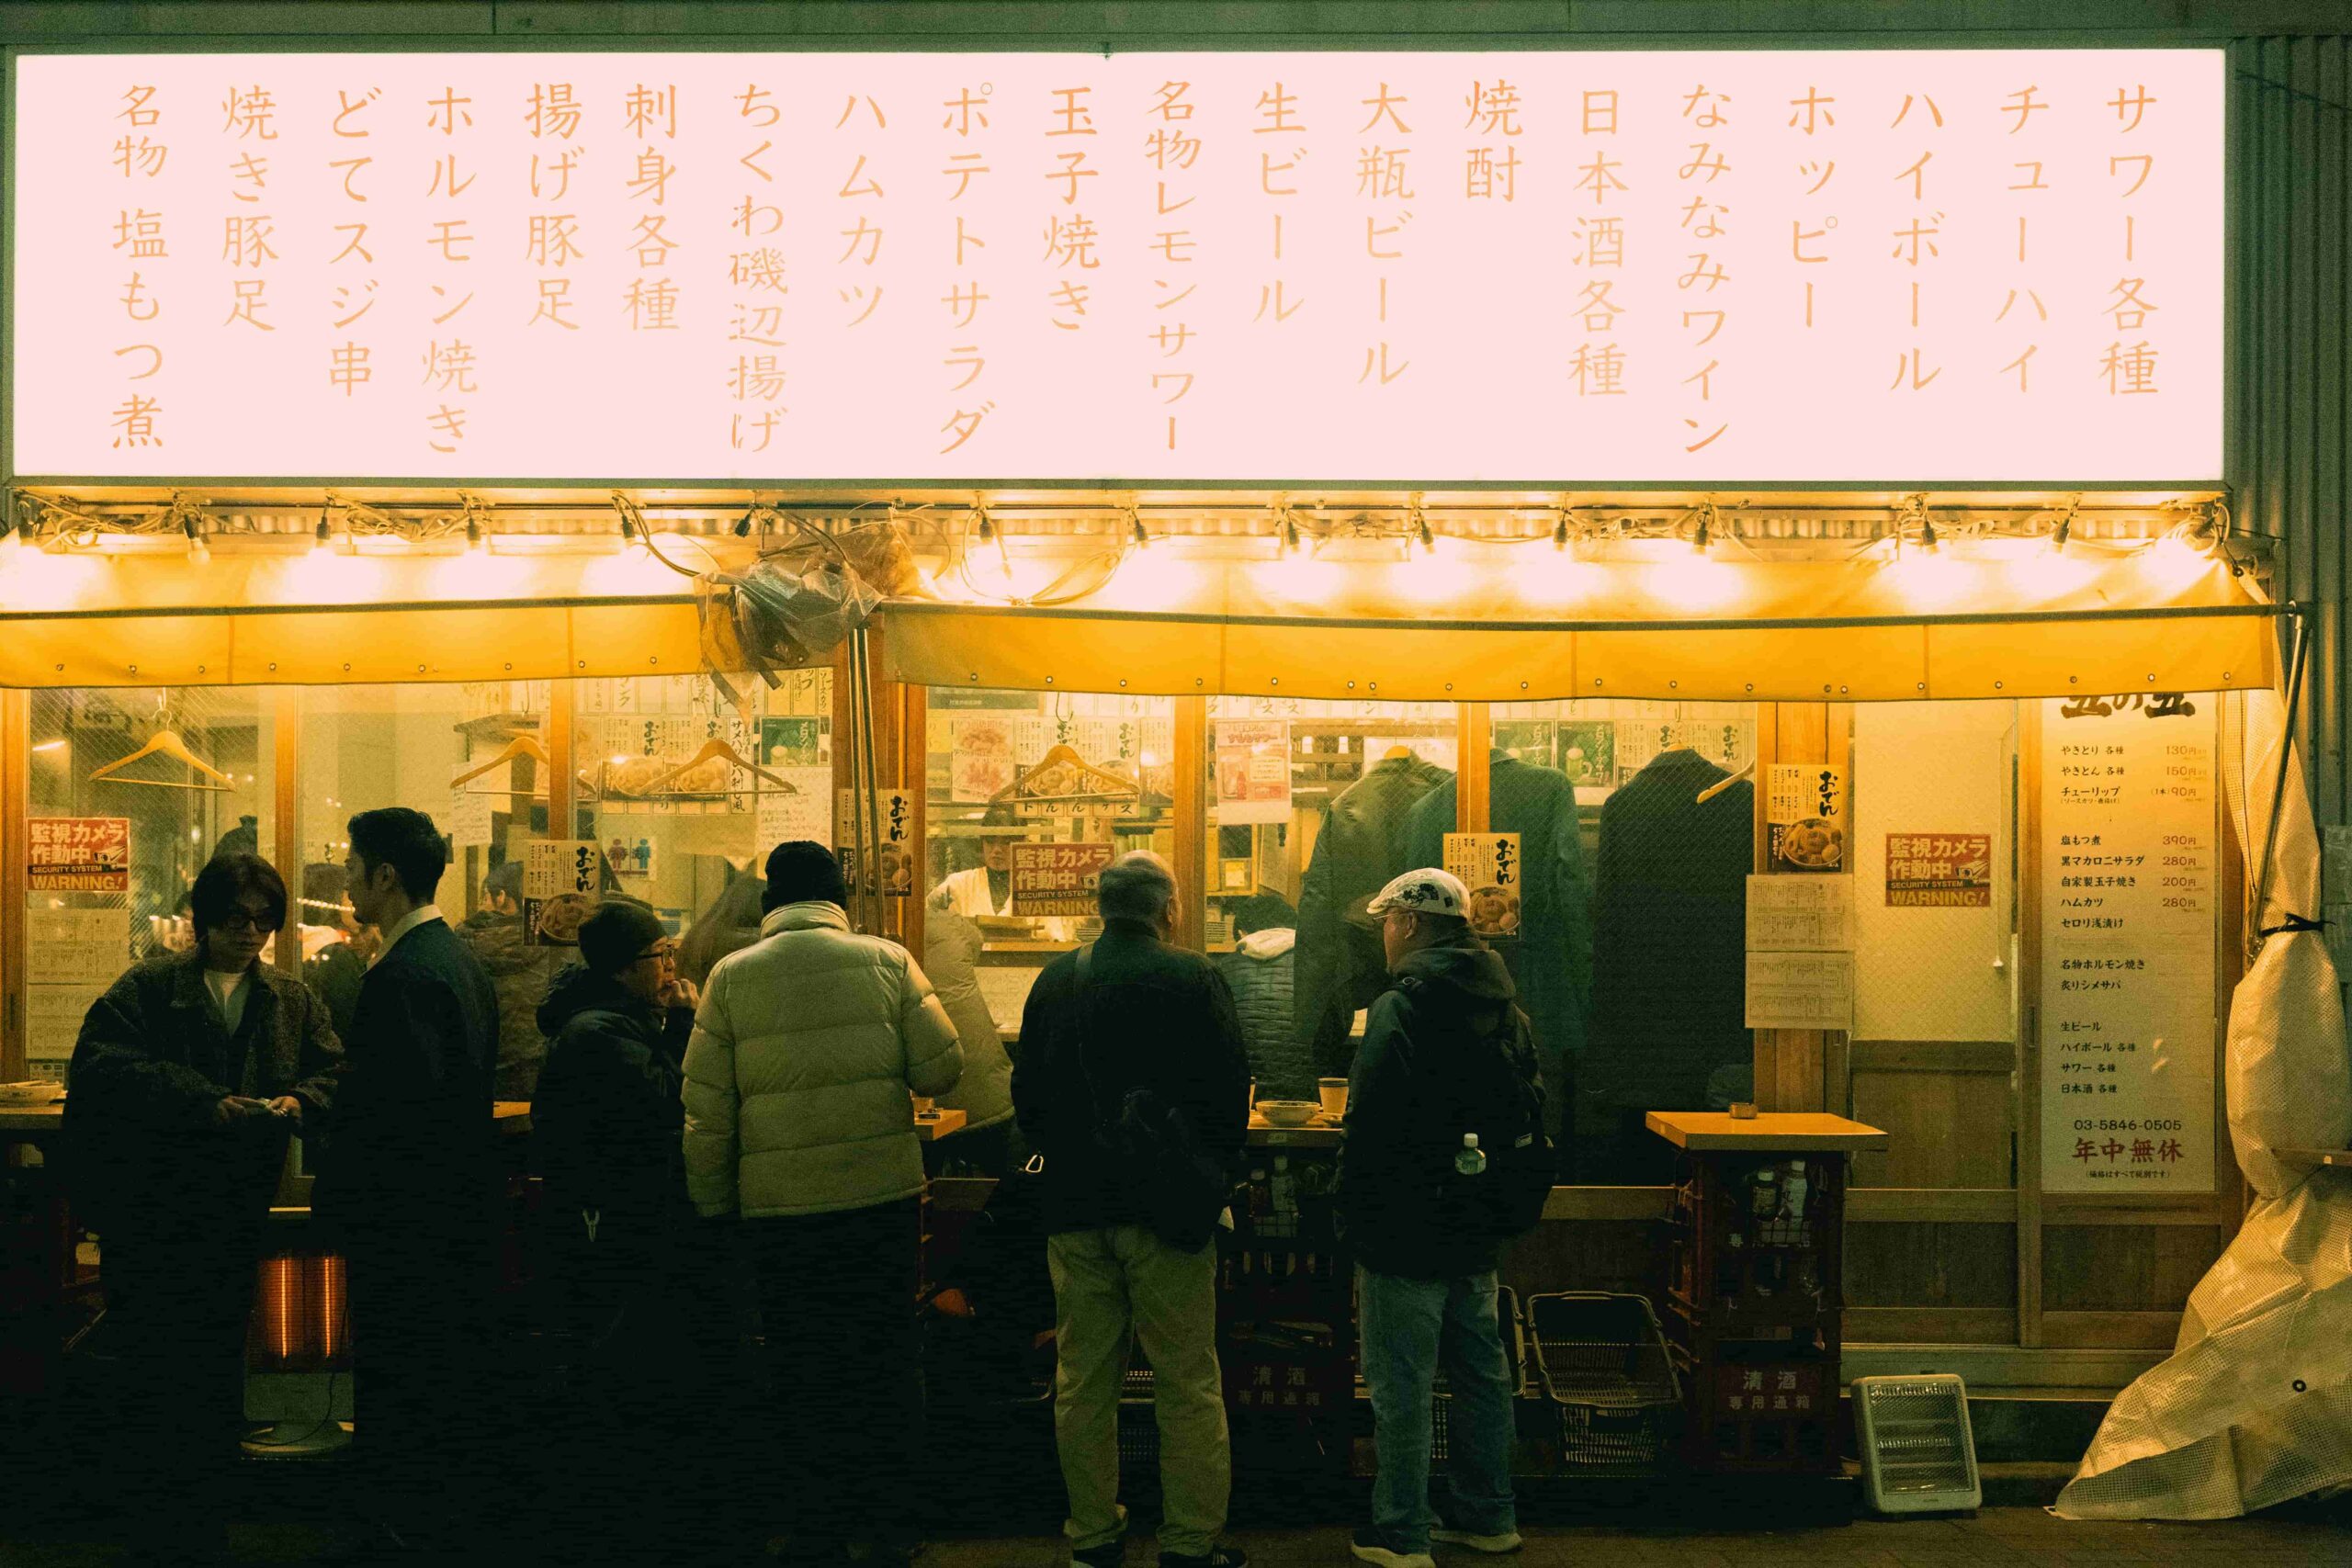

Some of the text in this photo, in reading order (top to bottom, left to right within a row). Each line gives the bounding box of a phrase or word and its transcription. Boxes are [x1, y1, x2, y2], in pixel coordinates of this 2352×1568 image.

[1464, 79, 1523, 202] 焼酎
[221, 85, 279, 332] 焼き豚足
[524, 83, 585, 331] 揚げ豚足
[623, 83, 680, 331] 刺身各種
[836, 95, 887, 326] ハムカツ
[1044, 86, 1101, 331] 玉子焼き
[1252, 82, 1307, 321] 生ビール
[1789, 85, 1838, 328] ホッピー
[329, 86, 382, 397] どてスジ串
[1356, 82, 1415, 385] 大瓶ビール
[1568, 90, 1629, 397] 日本酒各種
[1891, 85, 1945, 390] ハイボール
[1996, 85, 2050, 392] チューハイ
[2099, 84, 2159, 396] サワー各種
[423, 86, 478, 453] ホルモン焼き
[940, 82, 996, 455] ポテトサラダ
[1145, 81, 1202, 450] 名物レモンサワー
[1678, 84, 1731, 453] なみなみワイン
[643, 720, 661, 757] おでん
[1119, 722, 1136, 759] おでん
[1722, 725, 1739, 761] おでん
[2061, 746, 2098, 755] やきとり
[2106, 746, 2124, 755] 各種
[2061, 766, 2100, 776] やきとん
[2107, 766, 2124, 775] 各種
[1818, 771, 1838, 817] おでん
[2061, 786, 2120, 796] チューリップ
[30, 823, 125, 843] 監視カメラ
[889, 795, 910, 841] おでん
[30, 844, 91, 864] 作動中
[1890, 837, 1986, 858] 監視カメラ
[2061, 835, 2196, 846] 塩もつ煮 390円
[575, 846, 595, 892] おでん
[1015, 848, 1111, 869] 監視カメラ
[1496, 839, 1517, 886] おでん
[1889, 859, 1951, 880] 作動中
[2061, 855, 2196, 866] 黒マカロニサラダ 280円
[32, 875, 123, 890] WARNING!
[1015, 869, 1077, 890] 作動中
[1017, 889, 1089, 899] SECURITY SYSTEM
[1891, 880, 1963, 889] SECURITY SYSTEM
[2061, 876, 2196, 887] 自家製玉子焼き 200円
[2061, 897, 2196, 908] ハムカツ 280円
[2061, 918, 2123, 929] セロリ浅漬け
[2061, 959, 2145, 970] 名物ホルモン焼き
[2061, 1021, 2101, 1032] 生ビール
[2061, 1043, 2136, 1053] ハイボール 各種
[2061, 1063, 2116, 1073] サワー 各種
[2061, 1084, 2117, 1093] 日本酒 各種
[2074, 1119, 2182, 1131] 03-5846-0505
[2072, 1137, 2184, 1164] 年中無休
[1743, 1370, 1798, 1391] 清酒
